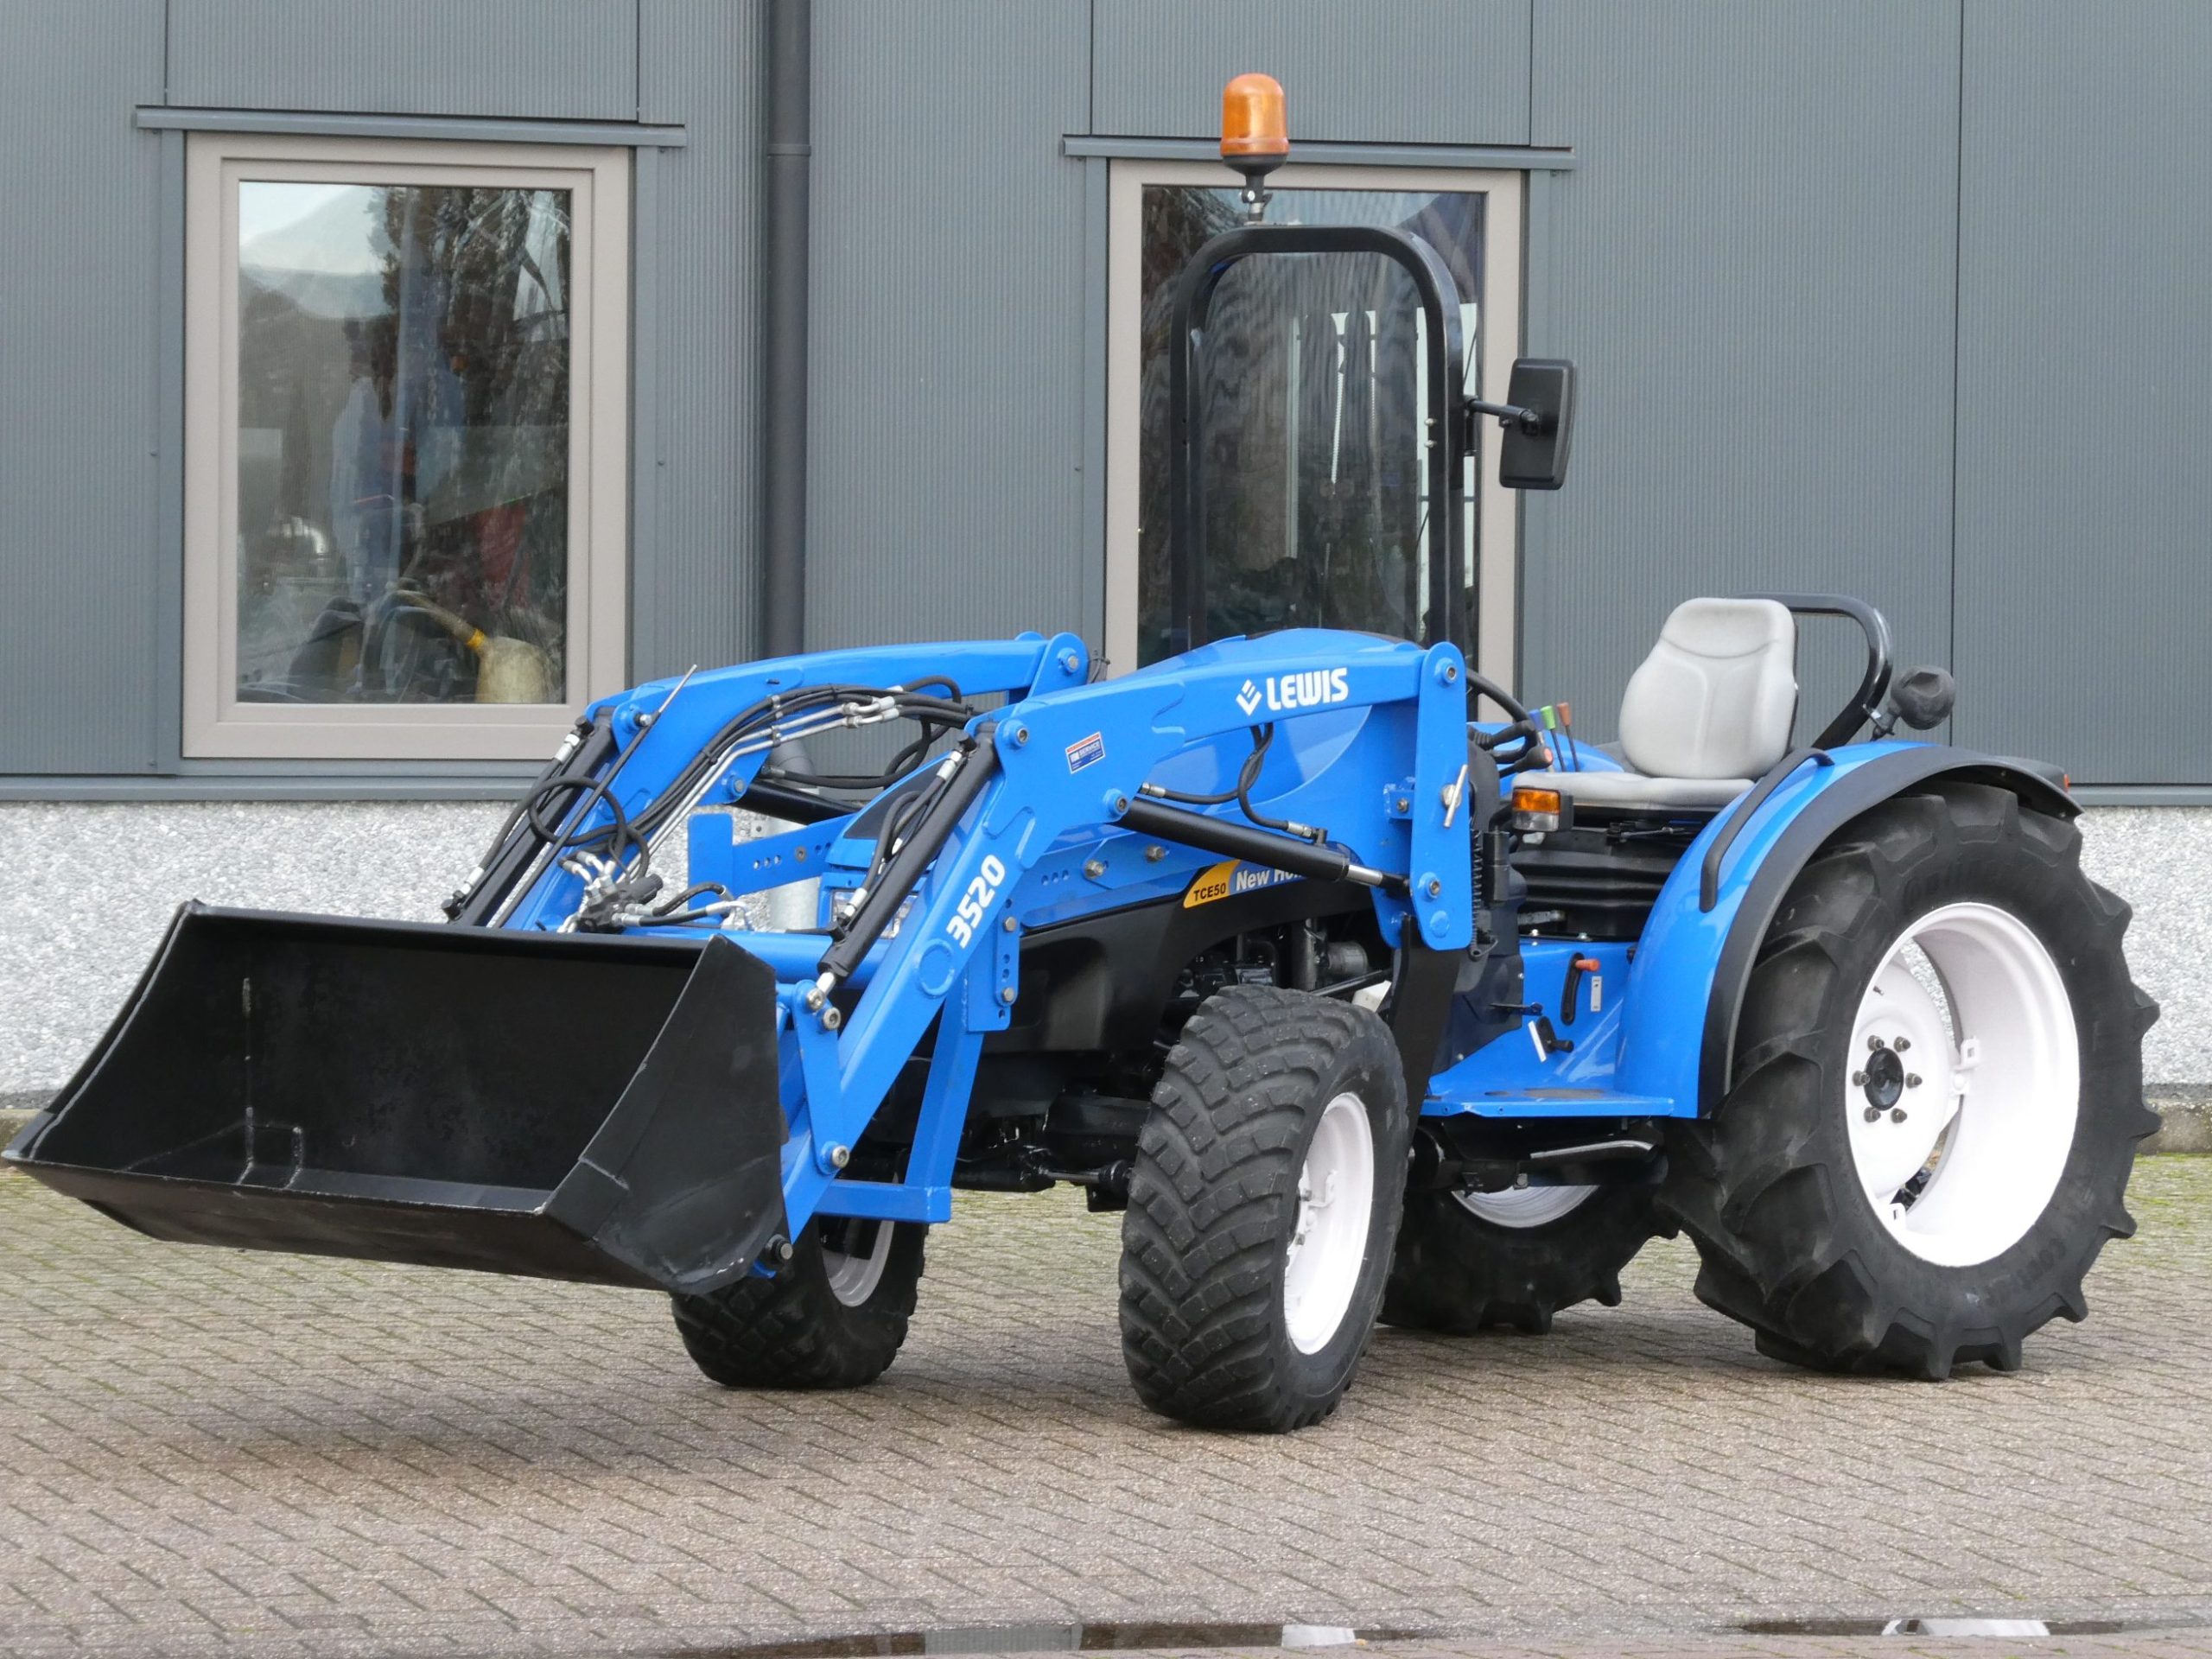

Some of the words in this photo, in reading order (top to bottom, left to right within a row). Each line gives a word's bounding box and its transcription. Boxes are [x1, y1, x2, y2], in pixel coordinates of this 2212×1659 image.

[1266, 667, 1349, 711] LEWIS
[1193, 882, 1226, 901] TCE50
[1236, 869, 1270, 892] New
[946, 854, 1006, 949] 3520
